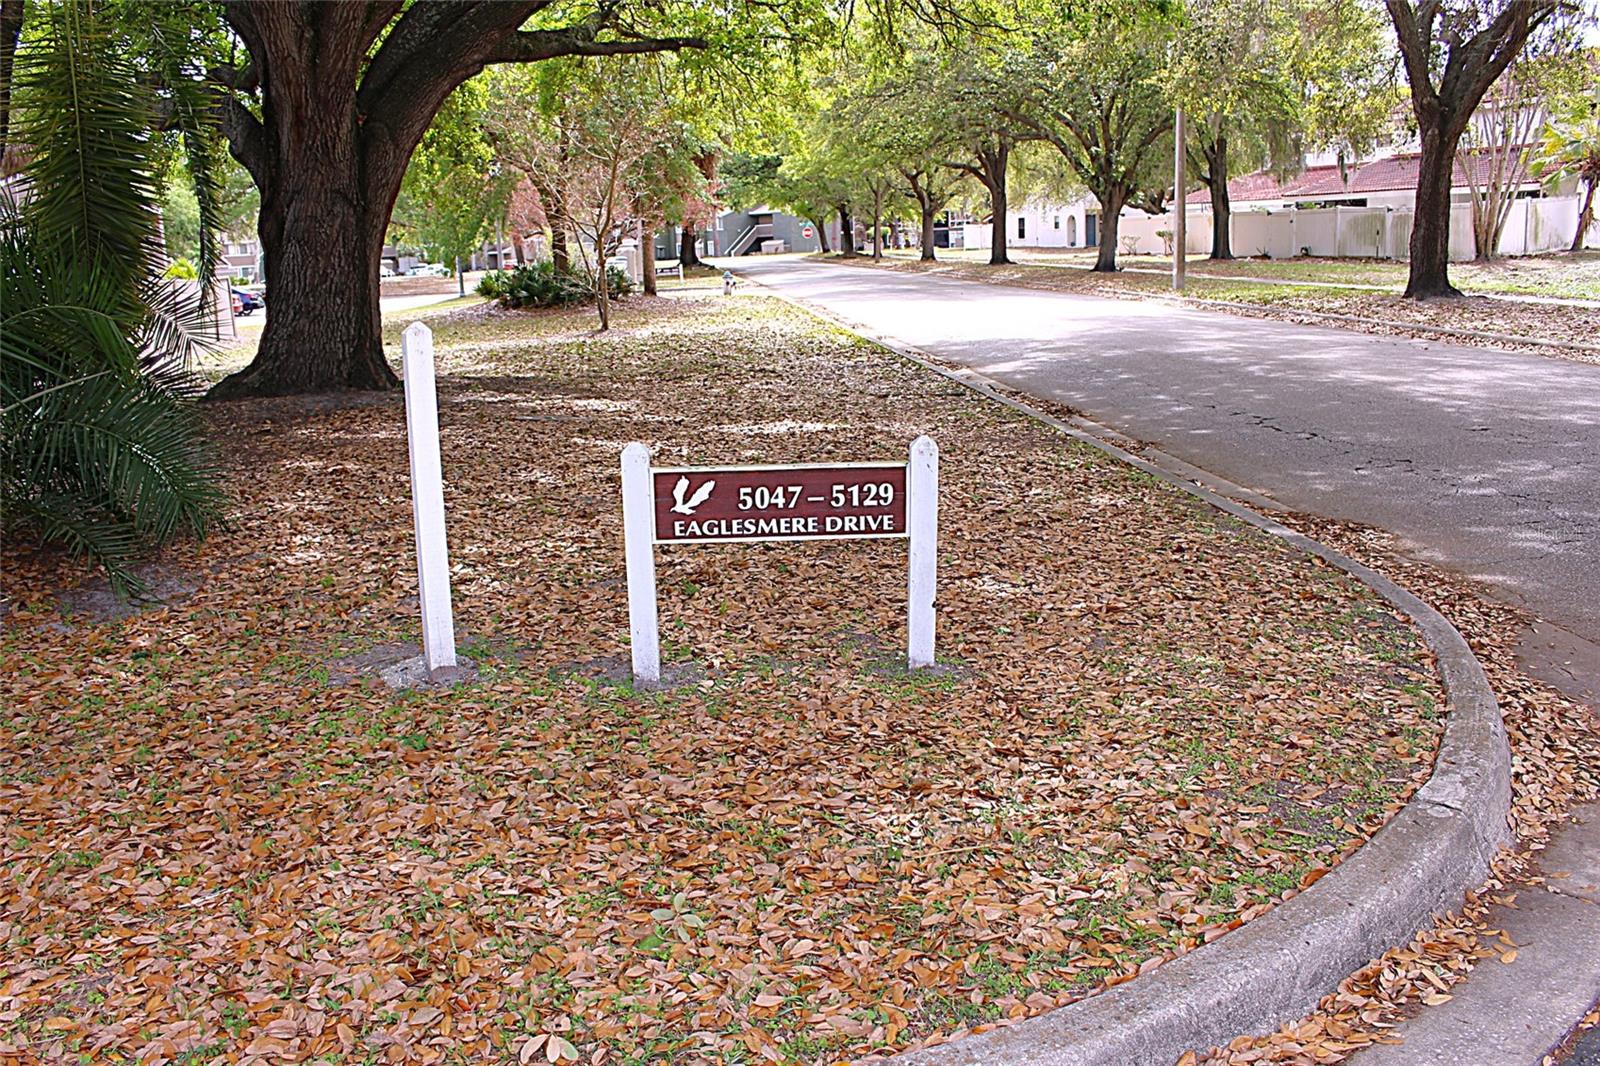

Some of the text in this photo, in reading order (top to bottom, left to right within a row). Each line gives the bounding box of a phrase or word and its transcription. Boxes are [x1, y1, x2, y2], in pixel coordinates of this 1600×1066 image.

[738, 486, 803, 510] 5047
[830, 482, 894, 508] 5129
[674, 514, 894, 537] EAGLESMERE DRIVE
